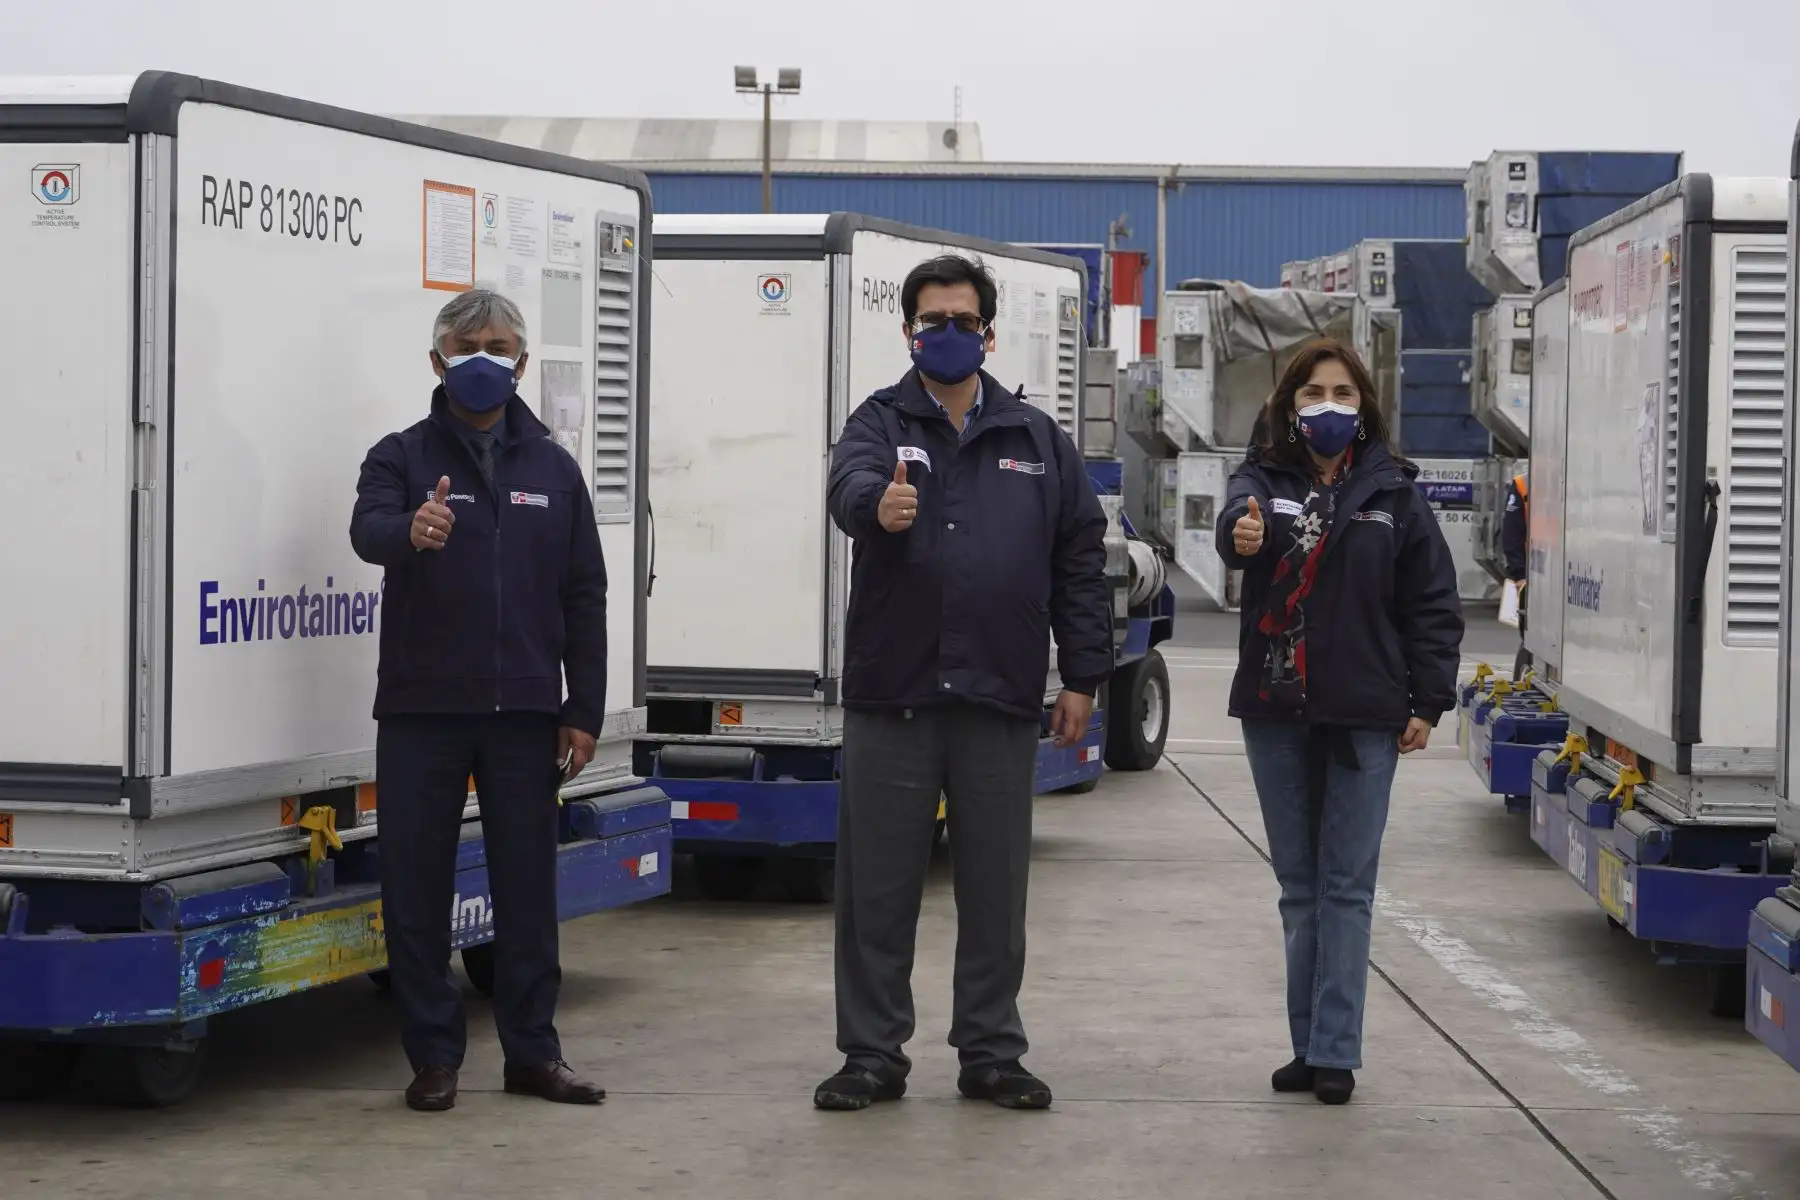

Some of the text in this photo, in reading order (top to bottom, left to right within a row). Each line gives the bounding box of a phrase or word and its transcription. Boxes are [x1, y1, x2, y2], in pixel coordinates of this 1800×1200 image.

[202, 174, 254, 229] RAP
[260, 184, 328, 241] 81306
[334, 196, 362, 246] PC
[1435, 485, 1467, 493] LATAM
[200, 576, 379, 645] Envirotainer
